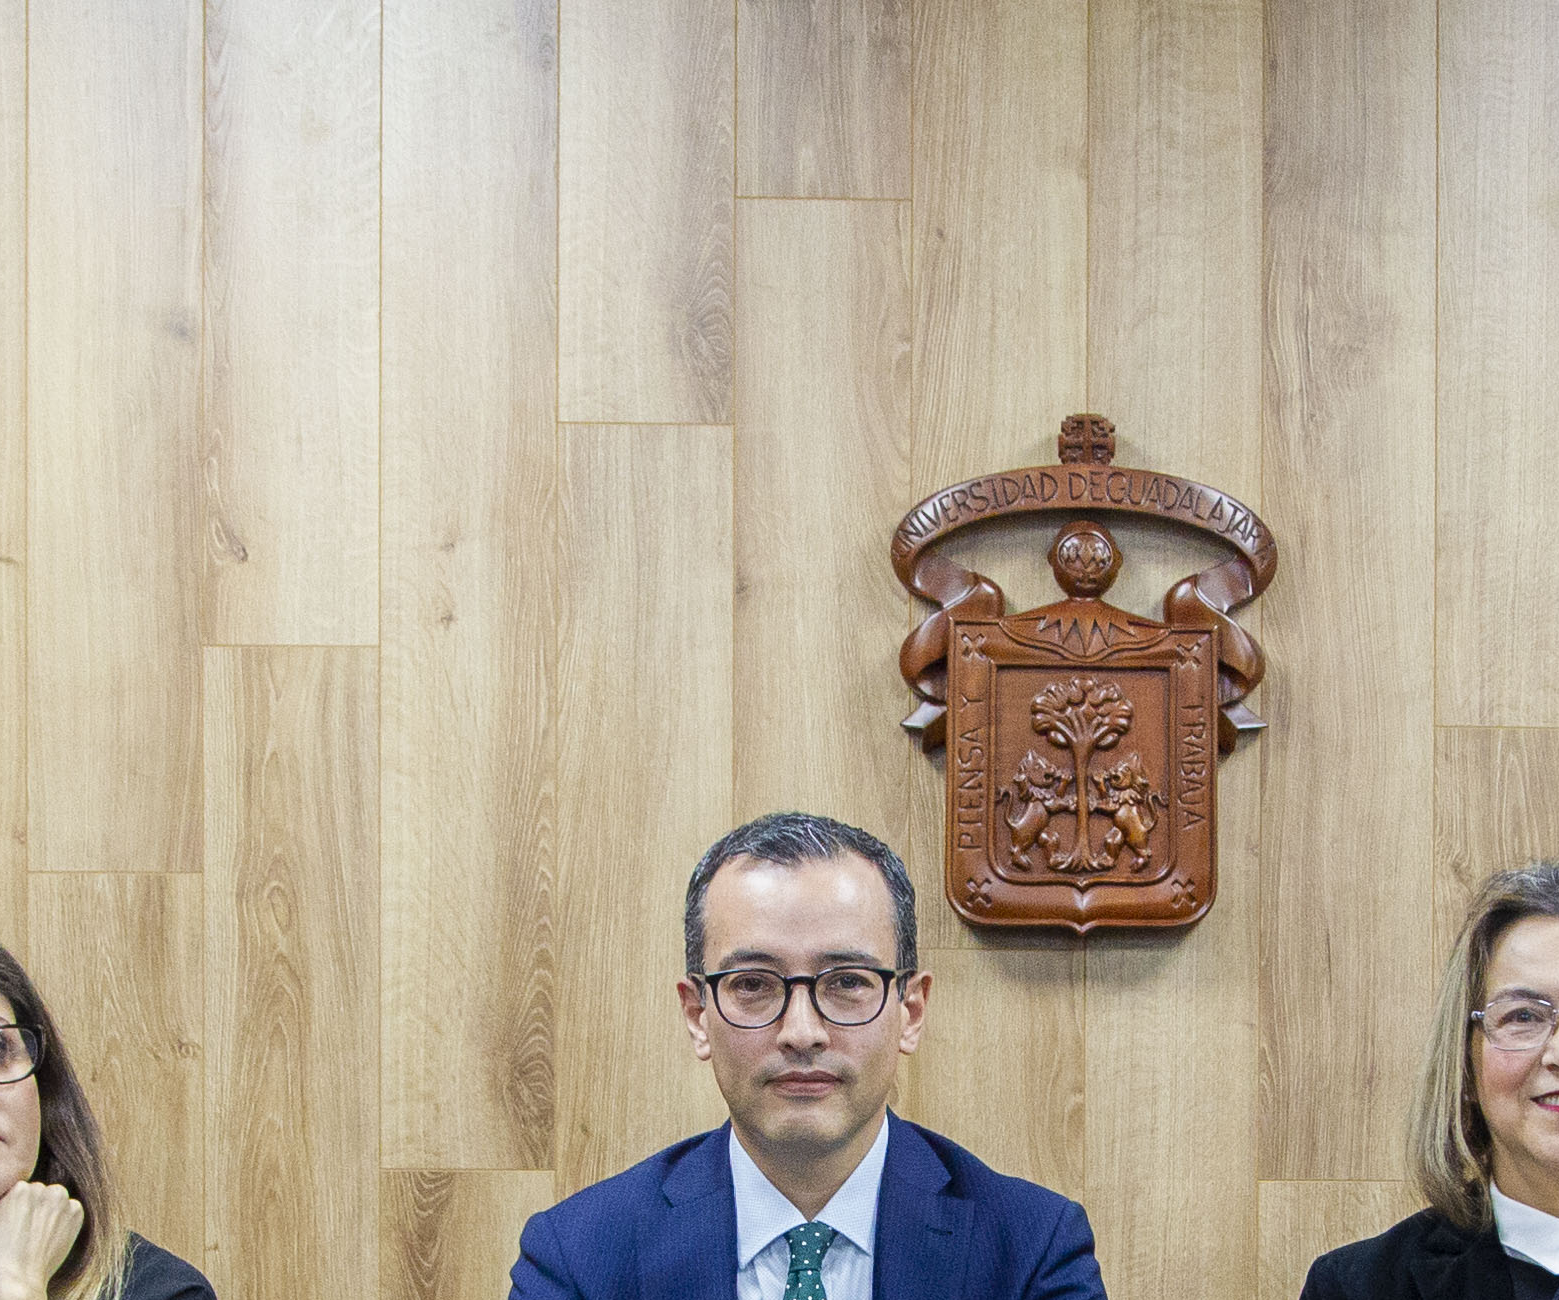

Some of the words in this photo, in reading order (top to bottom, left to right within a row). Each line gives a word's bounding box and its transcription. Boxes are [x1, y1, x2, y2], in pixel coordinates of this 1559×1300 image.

[895, 470, 1059, 552] UNIVERSIDAD
[960, 694, 984, 712] Y
[957, 727, 985, 850] PIENSA
[1179, 704, 1208, 831] TRABAJA
